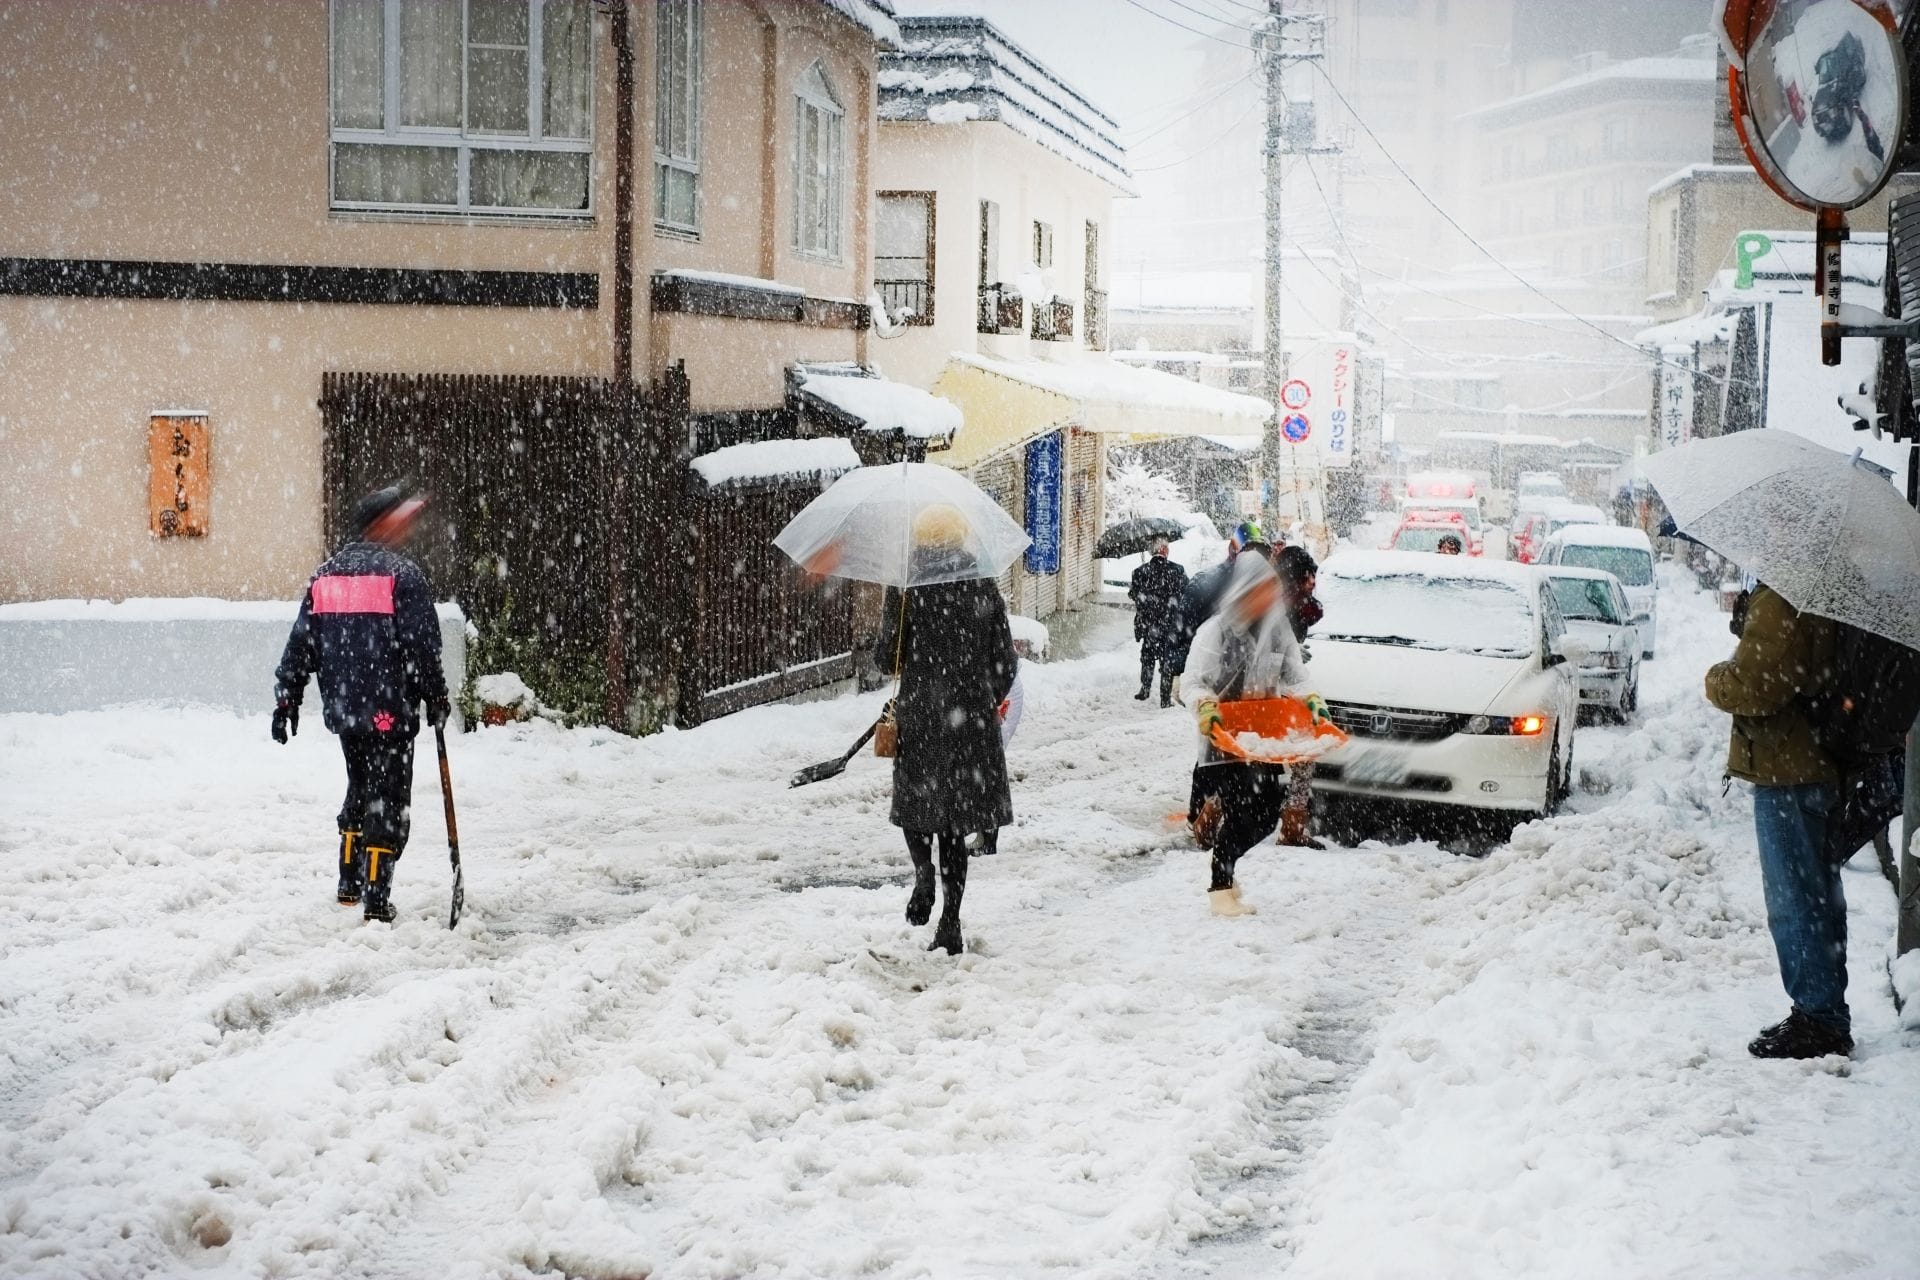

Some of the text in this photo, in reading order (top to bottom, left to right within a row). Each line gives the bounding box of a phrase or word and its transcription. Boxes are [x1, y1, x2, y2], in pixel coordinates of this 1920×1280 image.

[1735, 233, 1772, 290] P
[1827, 252, 1840, 317] 修善寺町
